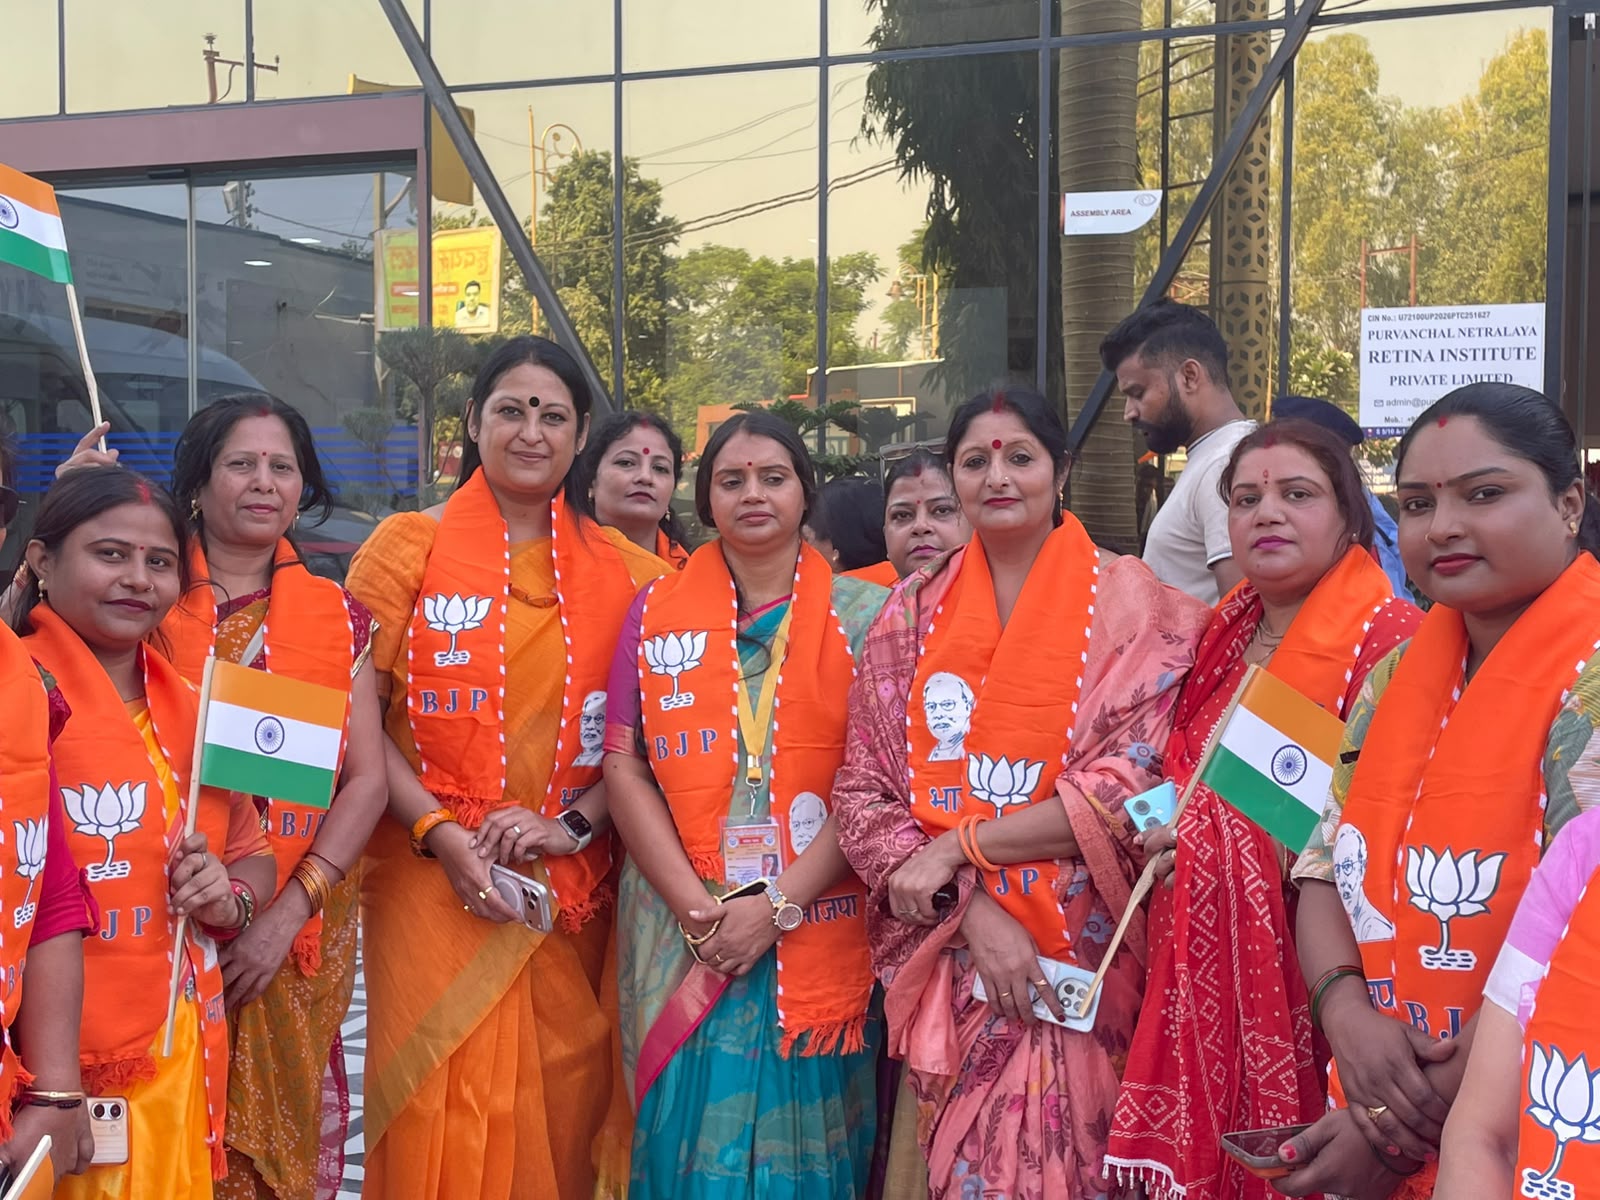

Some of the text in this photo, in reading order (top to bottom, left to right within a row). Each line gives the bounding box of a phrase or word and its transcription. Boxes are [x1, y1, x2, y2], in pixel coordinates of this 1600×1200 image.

[1070, 208, 1132, 217] ASSEMBLY AREA
[1367, 314, 1380, 322] CIN
[1368, 325, 1538, 341] PURVANCHAL NETRALAYA
[1368, 346, 1537, 364] RETINA INSTITUTE
[1390, 373, 1514, 386] PRIVATE LIMITED
[420, 688, 488, 714] BJP
[655, 729, 718, 760] BJP
[995, 866, 1040, 896] JP
[101, 905, 153, 941] JP
